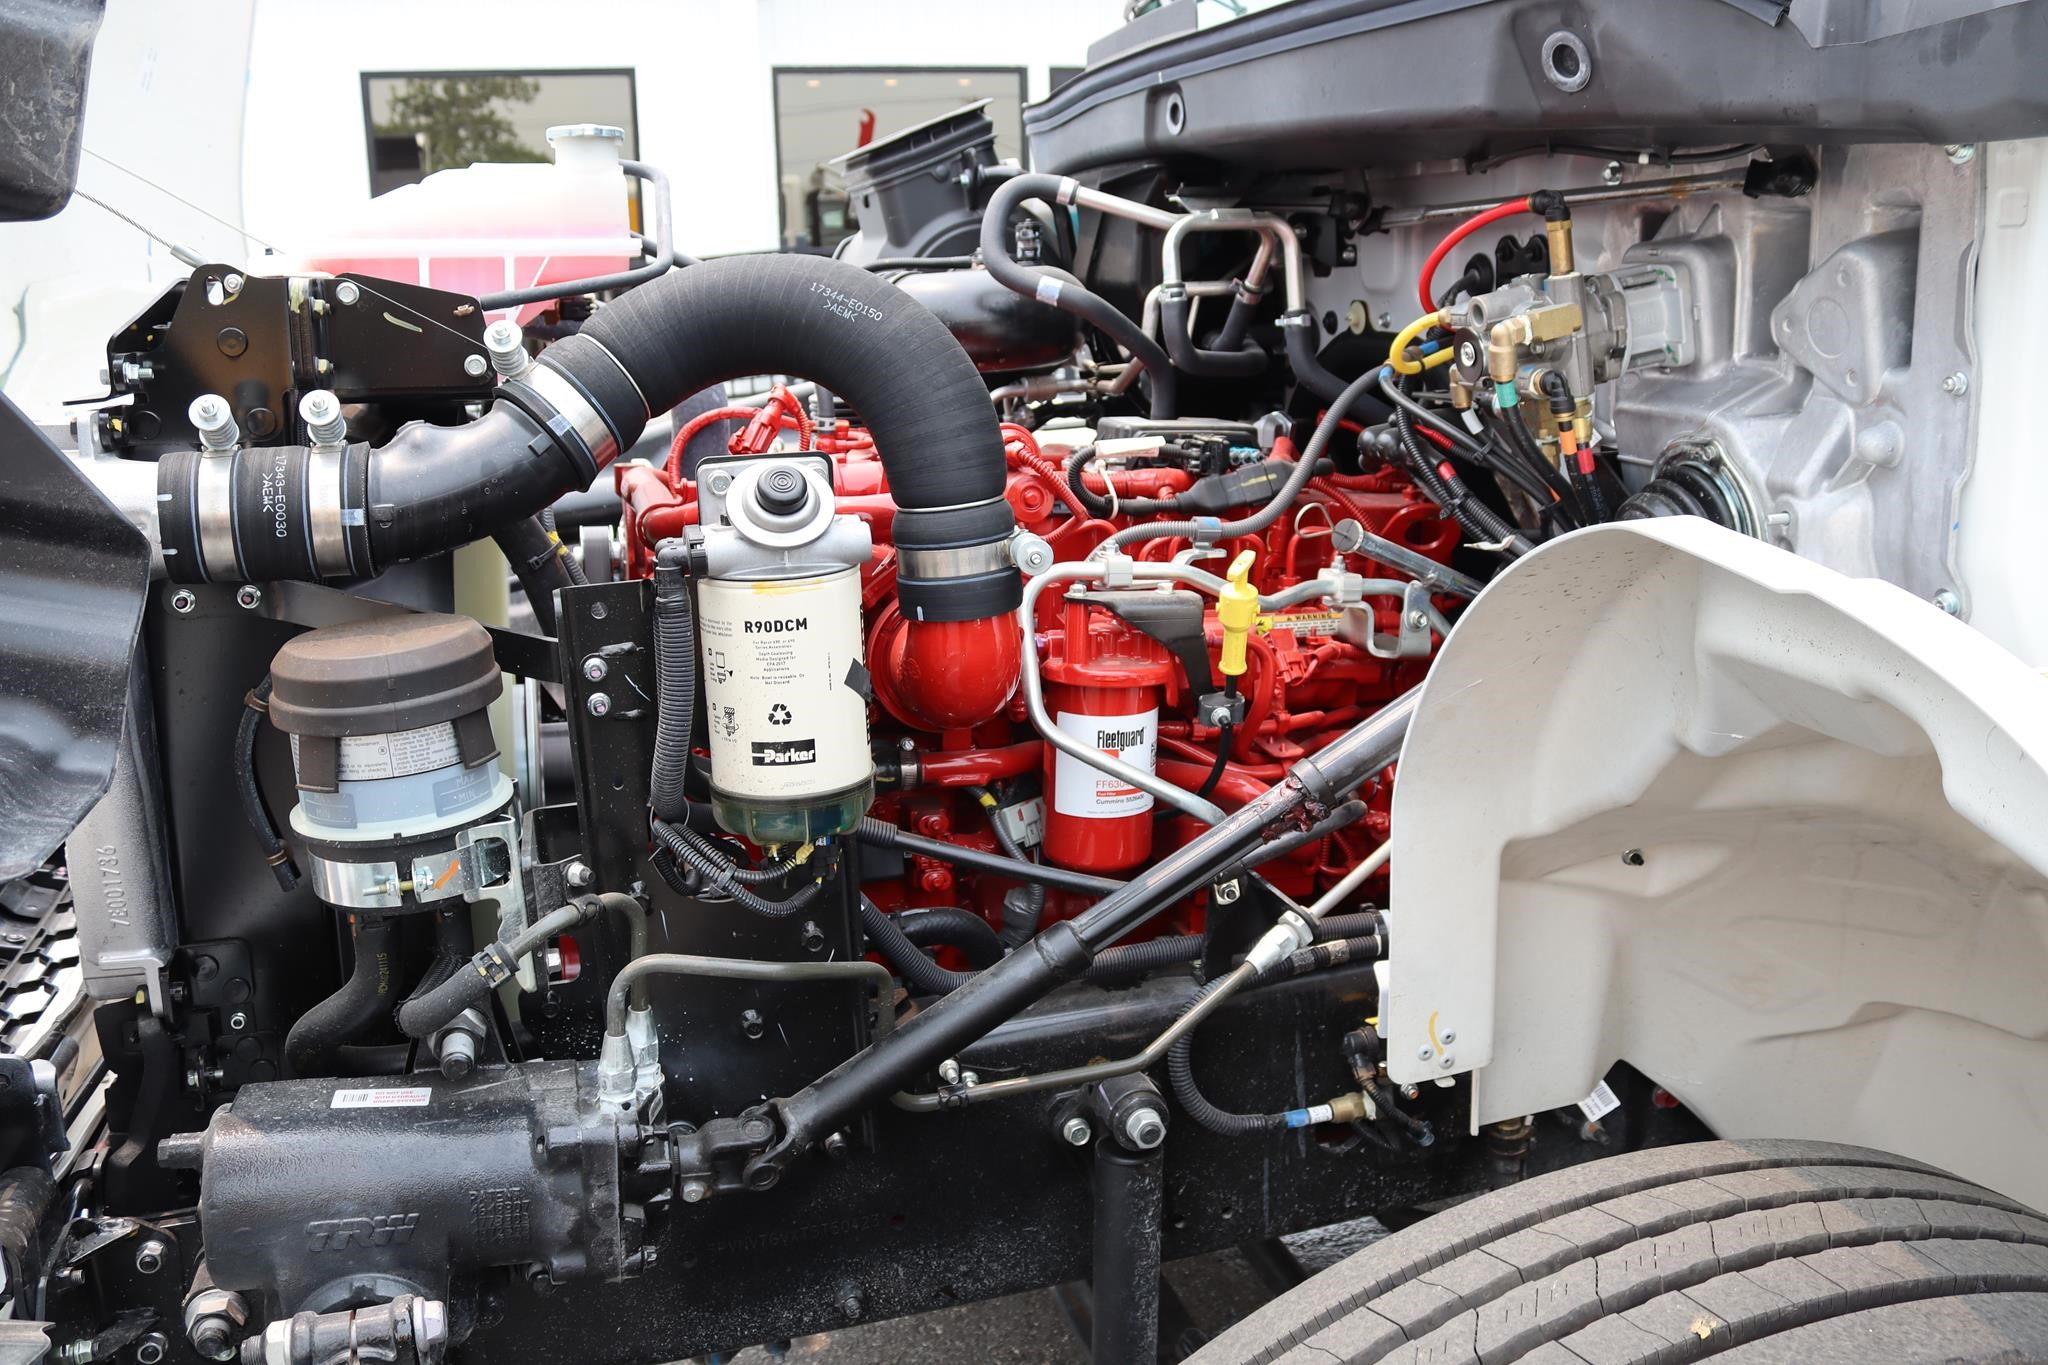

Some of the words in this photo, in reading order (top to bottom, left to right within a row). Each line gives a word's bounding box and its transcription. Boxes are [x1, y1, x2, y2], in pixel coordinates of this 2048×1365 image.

[810, 281, 883, 321] 17344-E0150
[275, 455, 287, 538] 17343-E0030
[744, 617, 808, 634] R90DCM
[1097, 726, 1145, 752] Fleetguard
[762, 748, 815, 764] Parker
[304, 1212, 420, 1253] TRW
